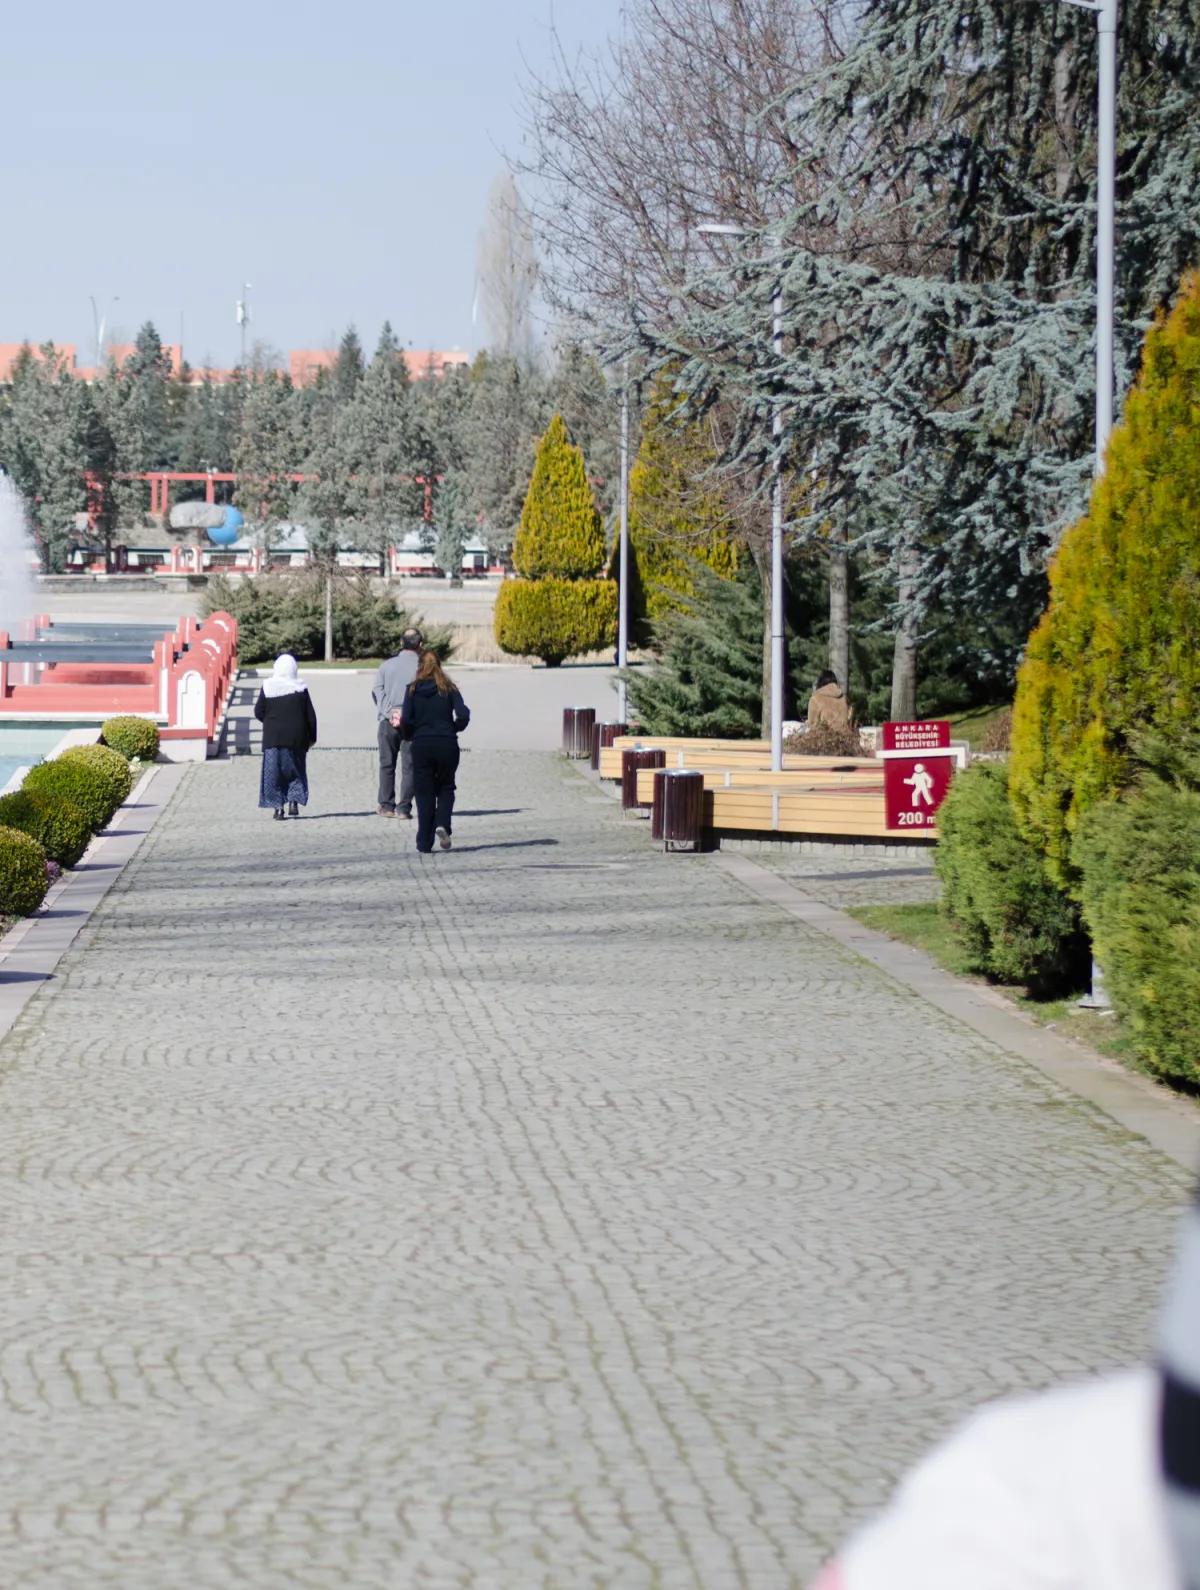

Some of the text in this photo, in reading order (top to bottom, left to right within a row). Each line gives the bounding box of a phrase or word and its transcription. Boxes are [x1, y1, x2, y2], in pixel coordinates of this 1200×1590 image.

[895, 724, 938, 732] ANKARA
[895, 739, 938, 748] BELEDİYESİ
[898, 811, 923, 825] 200
